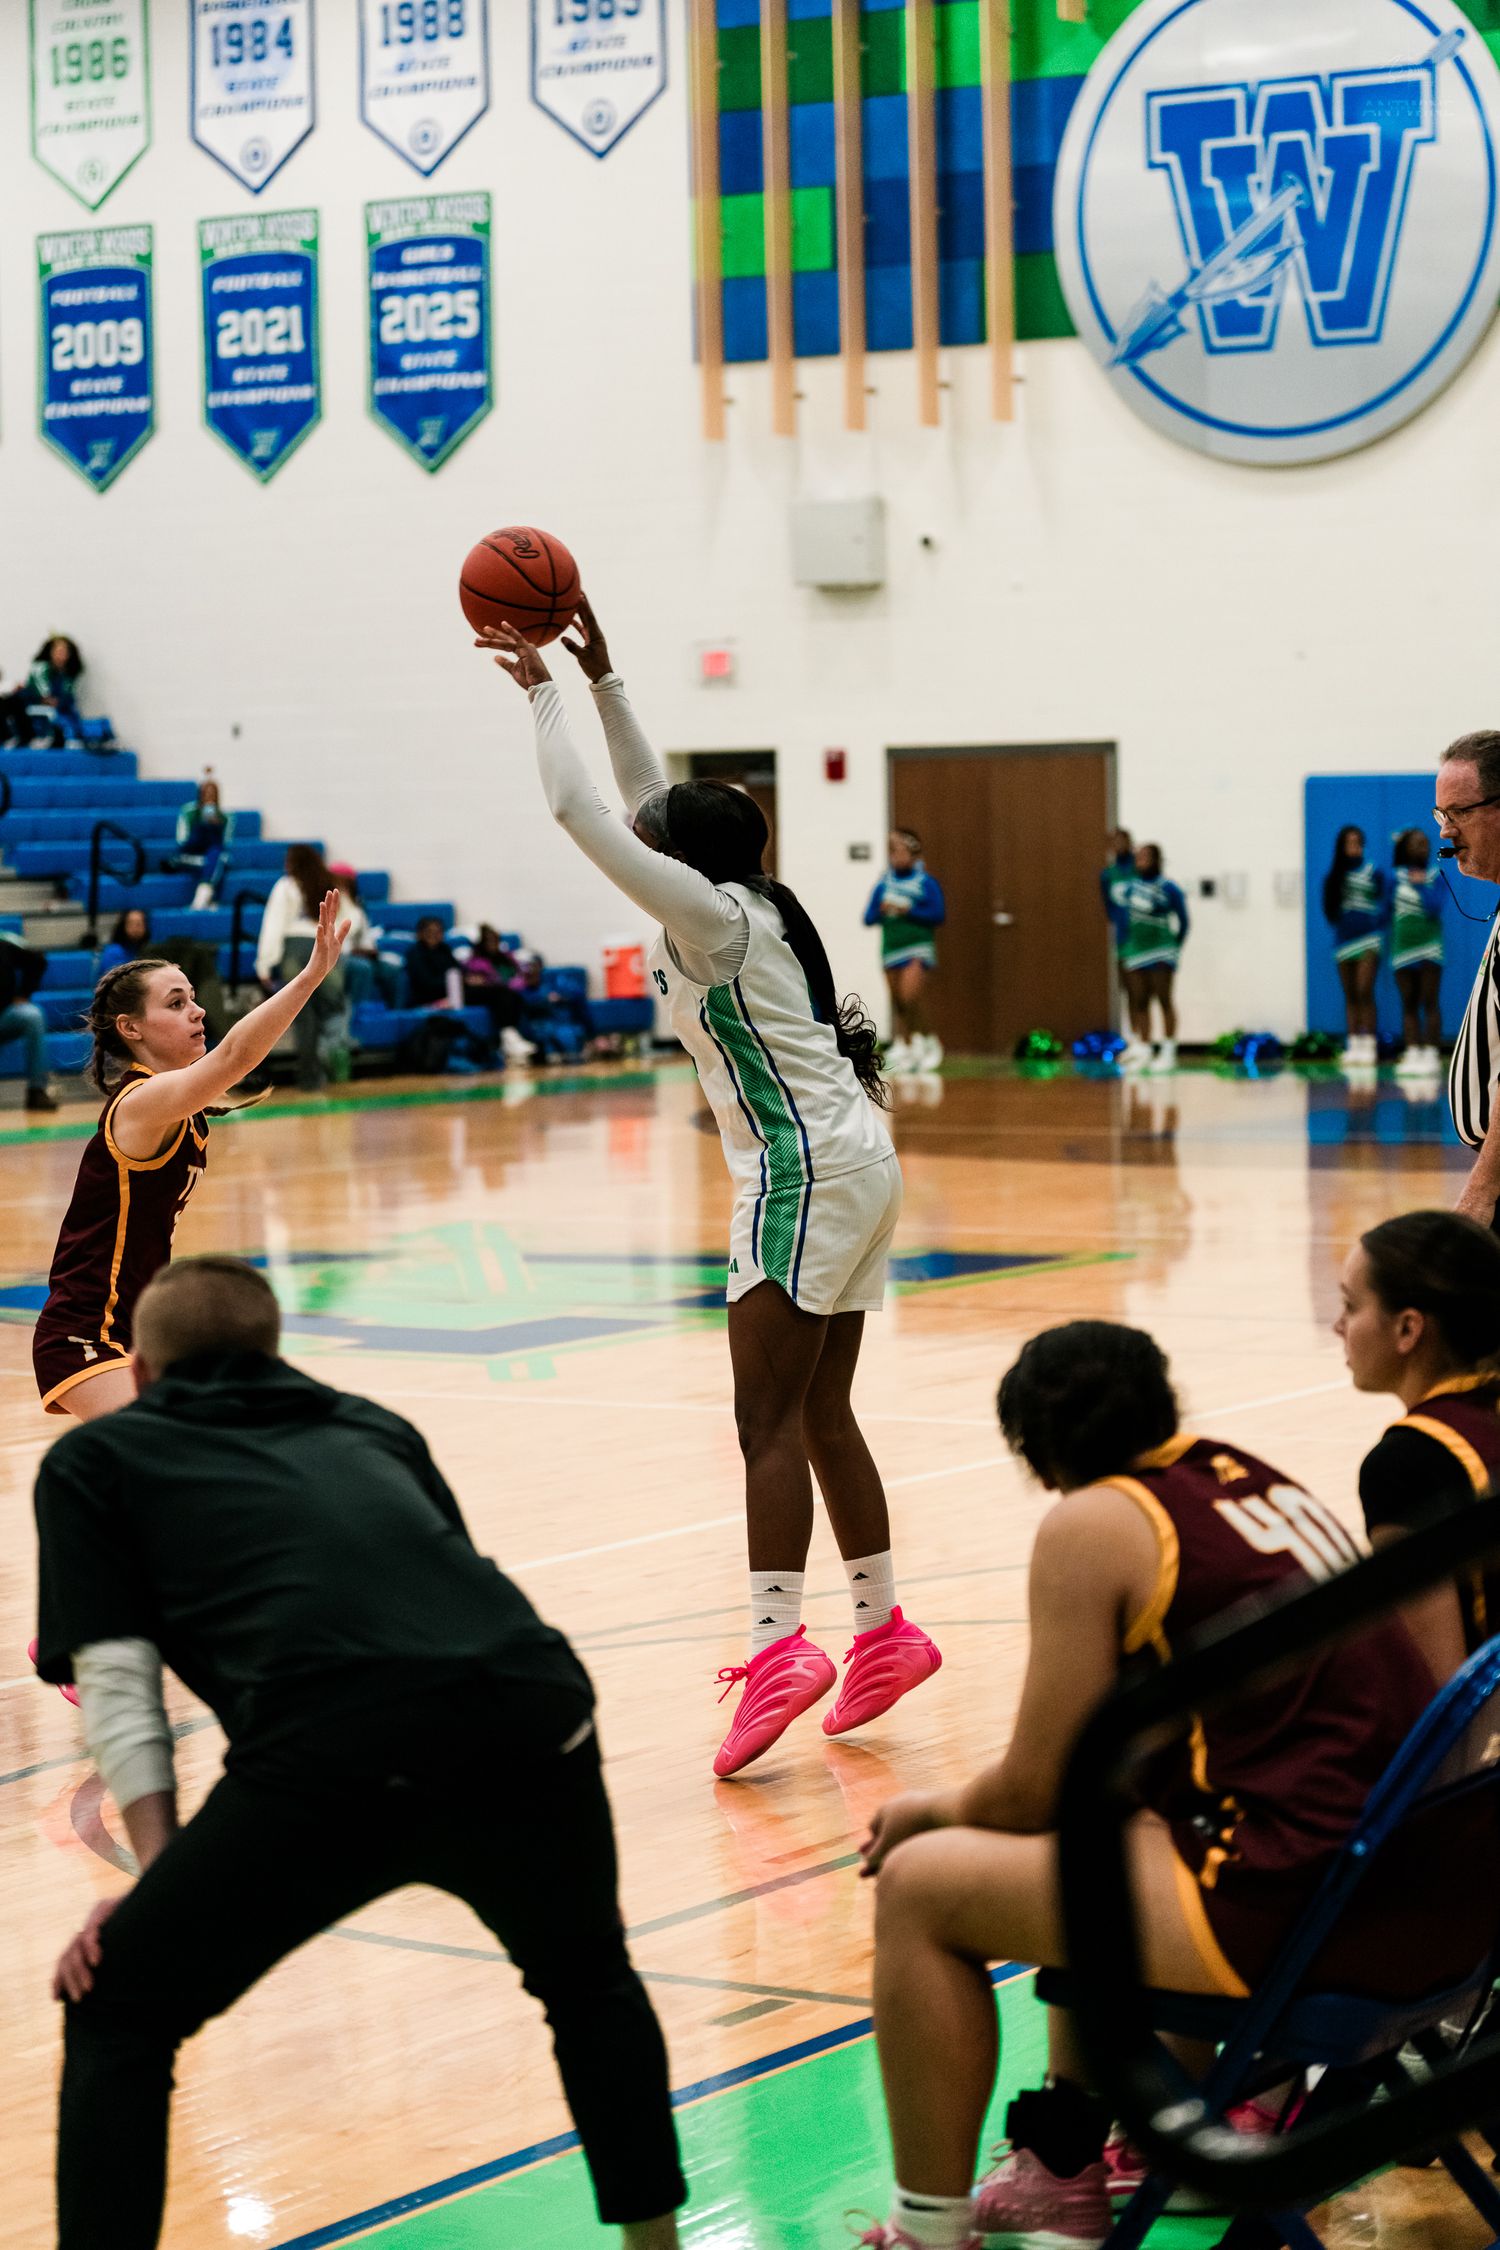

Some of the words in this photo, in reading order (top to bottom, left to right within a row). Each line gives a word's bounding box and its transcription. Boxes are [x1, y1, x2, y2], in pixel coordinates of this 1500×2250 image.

[210, 16, 294, 69] 1984
[380, 0, 466, 48] 1988
[52, 36, 129, 88] 1986
[1146, 73, 1436, 355] W
[216, 304, 305, 359] 2021
[380, 289, 480, 344] 2025
[52, 318, 144, 371] 2009
